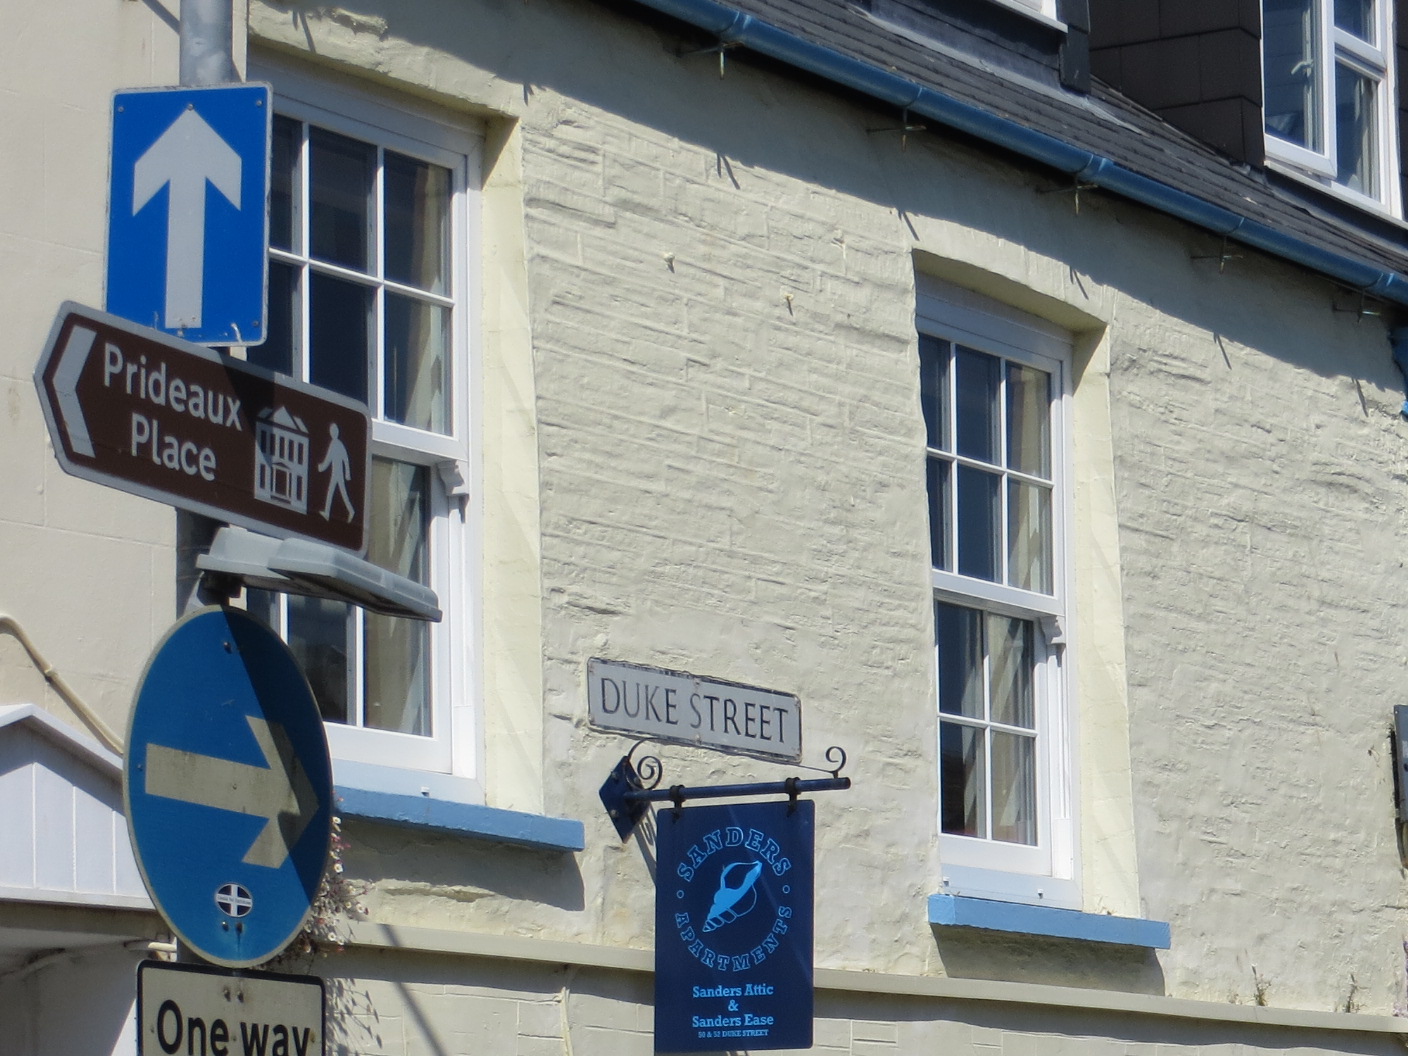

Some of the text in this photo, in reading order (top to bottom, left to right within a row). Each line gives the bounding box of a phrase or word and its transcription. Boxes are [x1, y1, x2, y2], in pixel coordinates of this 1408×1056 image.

[104, 342, 242, 432] Prideaux
[131, 412, 217, 481] Place
[601, 677, 789, 743] DUKE STREET
[677, 826, 792, 882] SANDERS
[675, 905, 793, 972] APARTMENTS
[692, 983, 774, 998] Sanders Attic
[727, 999, 739, 1012] &
[692, 1013, 774, 1028] Sanders Ease
[742, 1029, 769, 1037] STREET
